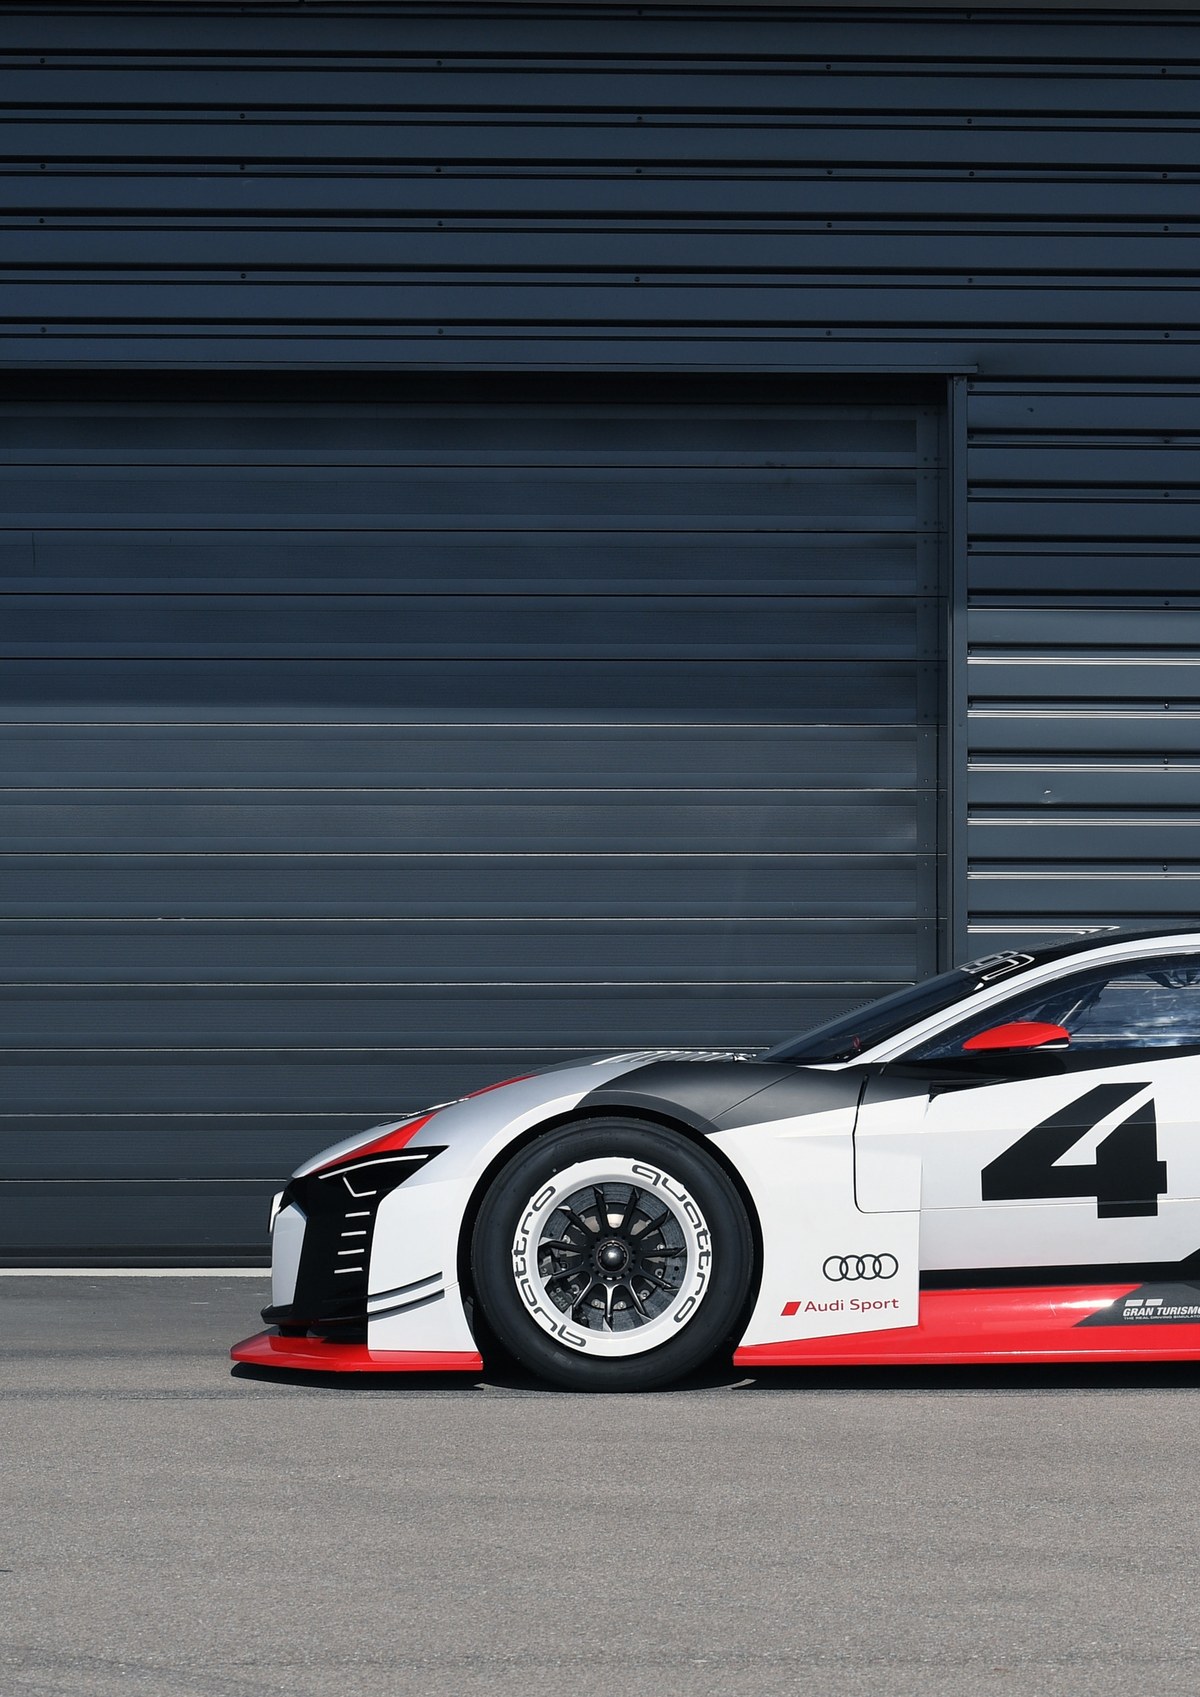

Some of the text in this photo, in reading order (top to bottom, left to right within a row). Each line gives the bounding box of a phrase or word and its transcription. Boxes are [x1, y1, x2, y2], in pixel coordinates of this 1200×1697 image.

[980, 1081, 1168, 1219] 4
[512, 1185, 587, 1348] quattro
[632, 1164, 712, 1324] quattro
[804, 1298, 900, 1313] Audi Sport
[1122, 1306, 1154, 1317] GRAN
